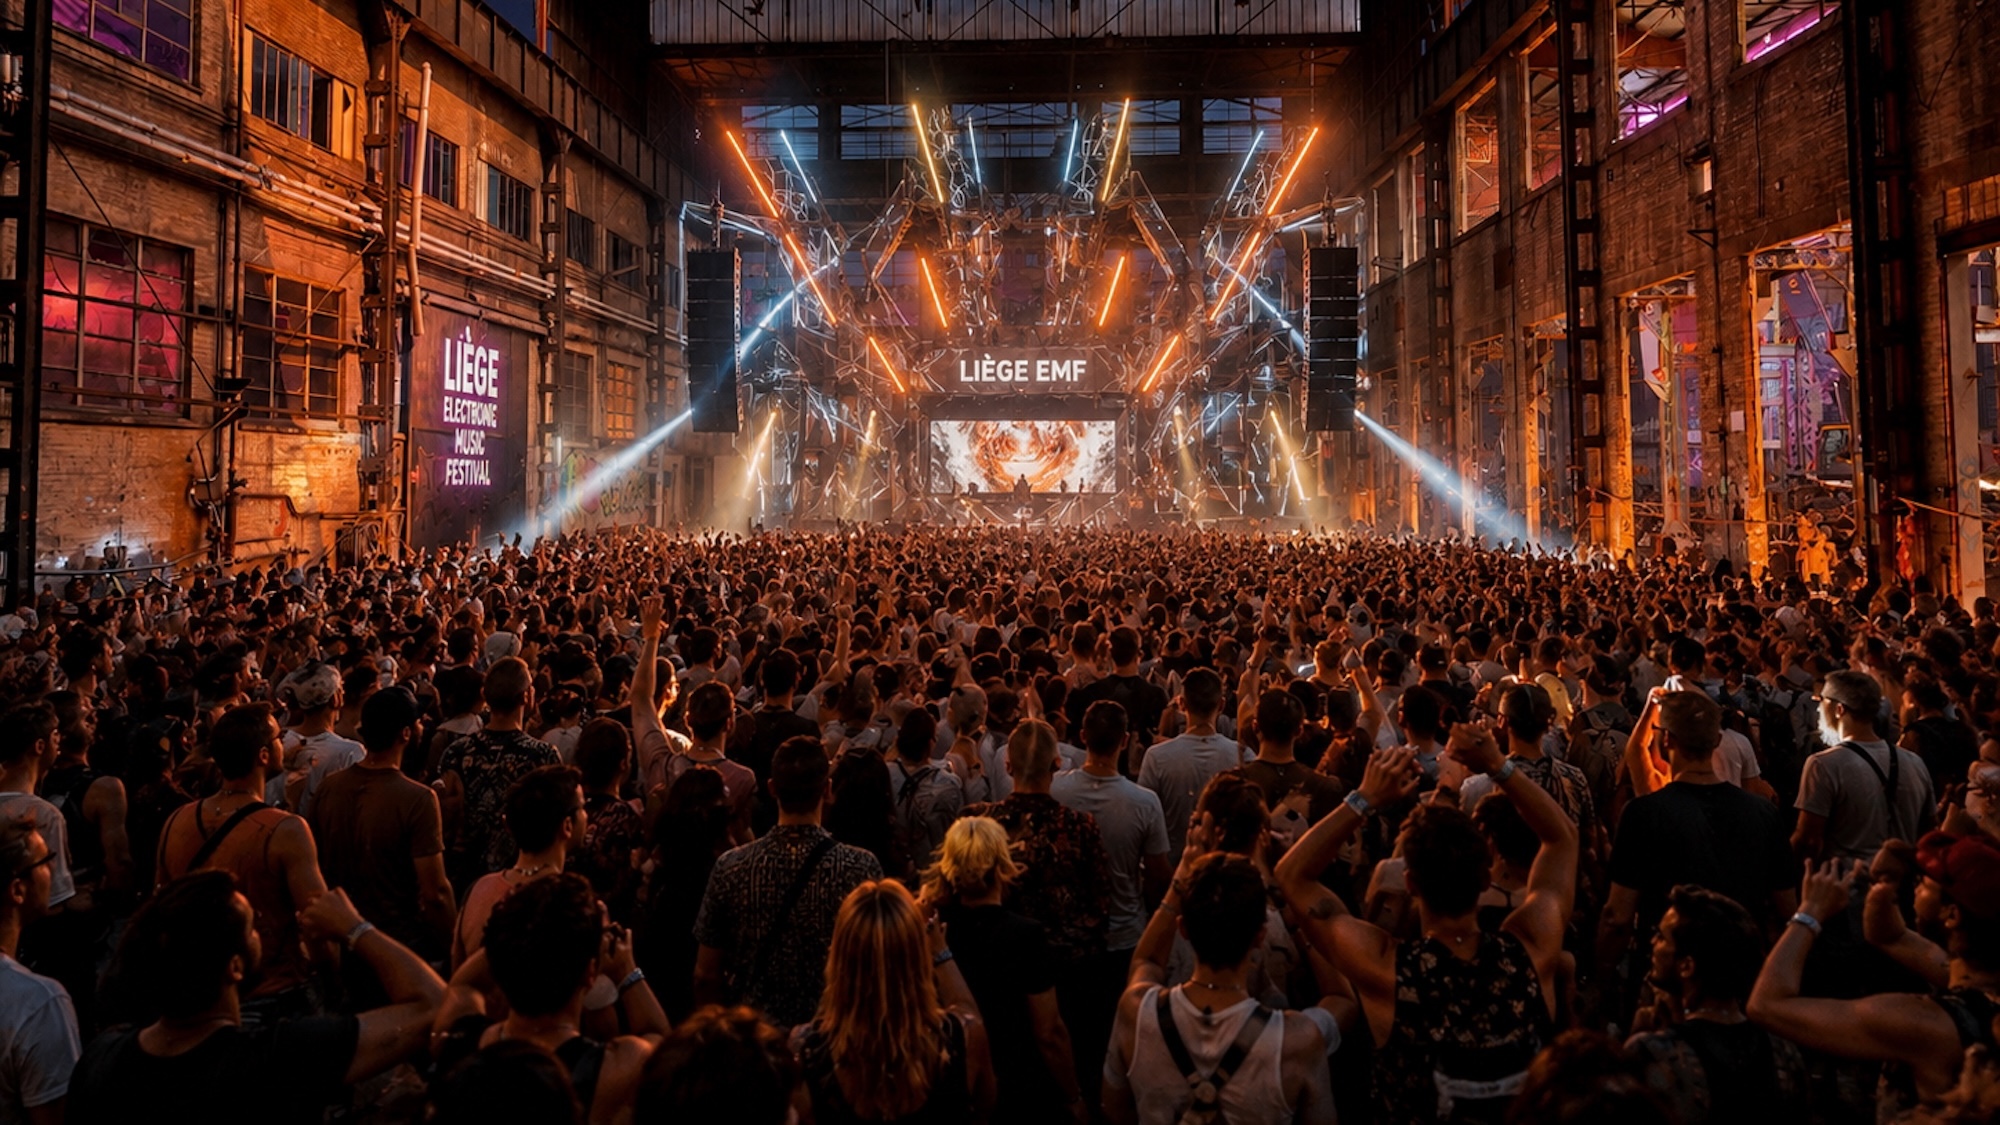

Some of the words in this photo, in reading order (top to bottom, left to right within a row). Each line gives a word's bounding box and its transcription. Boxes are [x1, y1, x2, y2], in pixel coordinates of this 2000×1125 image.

[444, 325, 500, 398] LIÈGE
[960, 353, 1029, 381] LIÈGE
[1036, 360, 1087, 381] EMF
[455, 428, 486, 455] MUSIC
[445, 458, 491, 486] FESTIVAL
